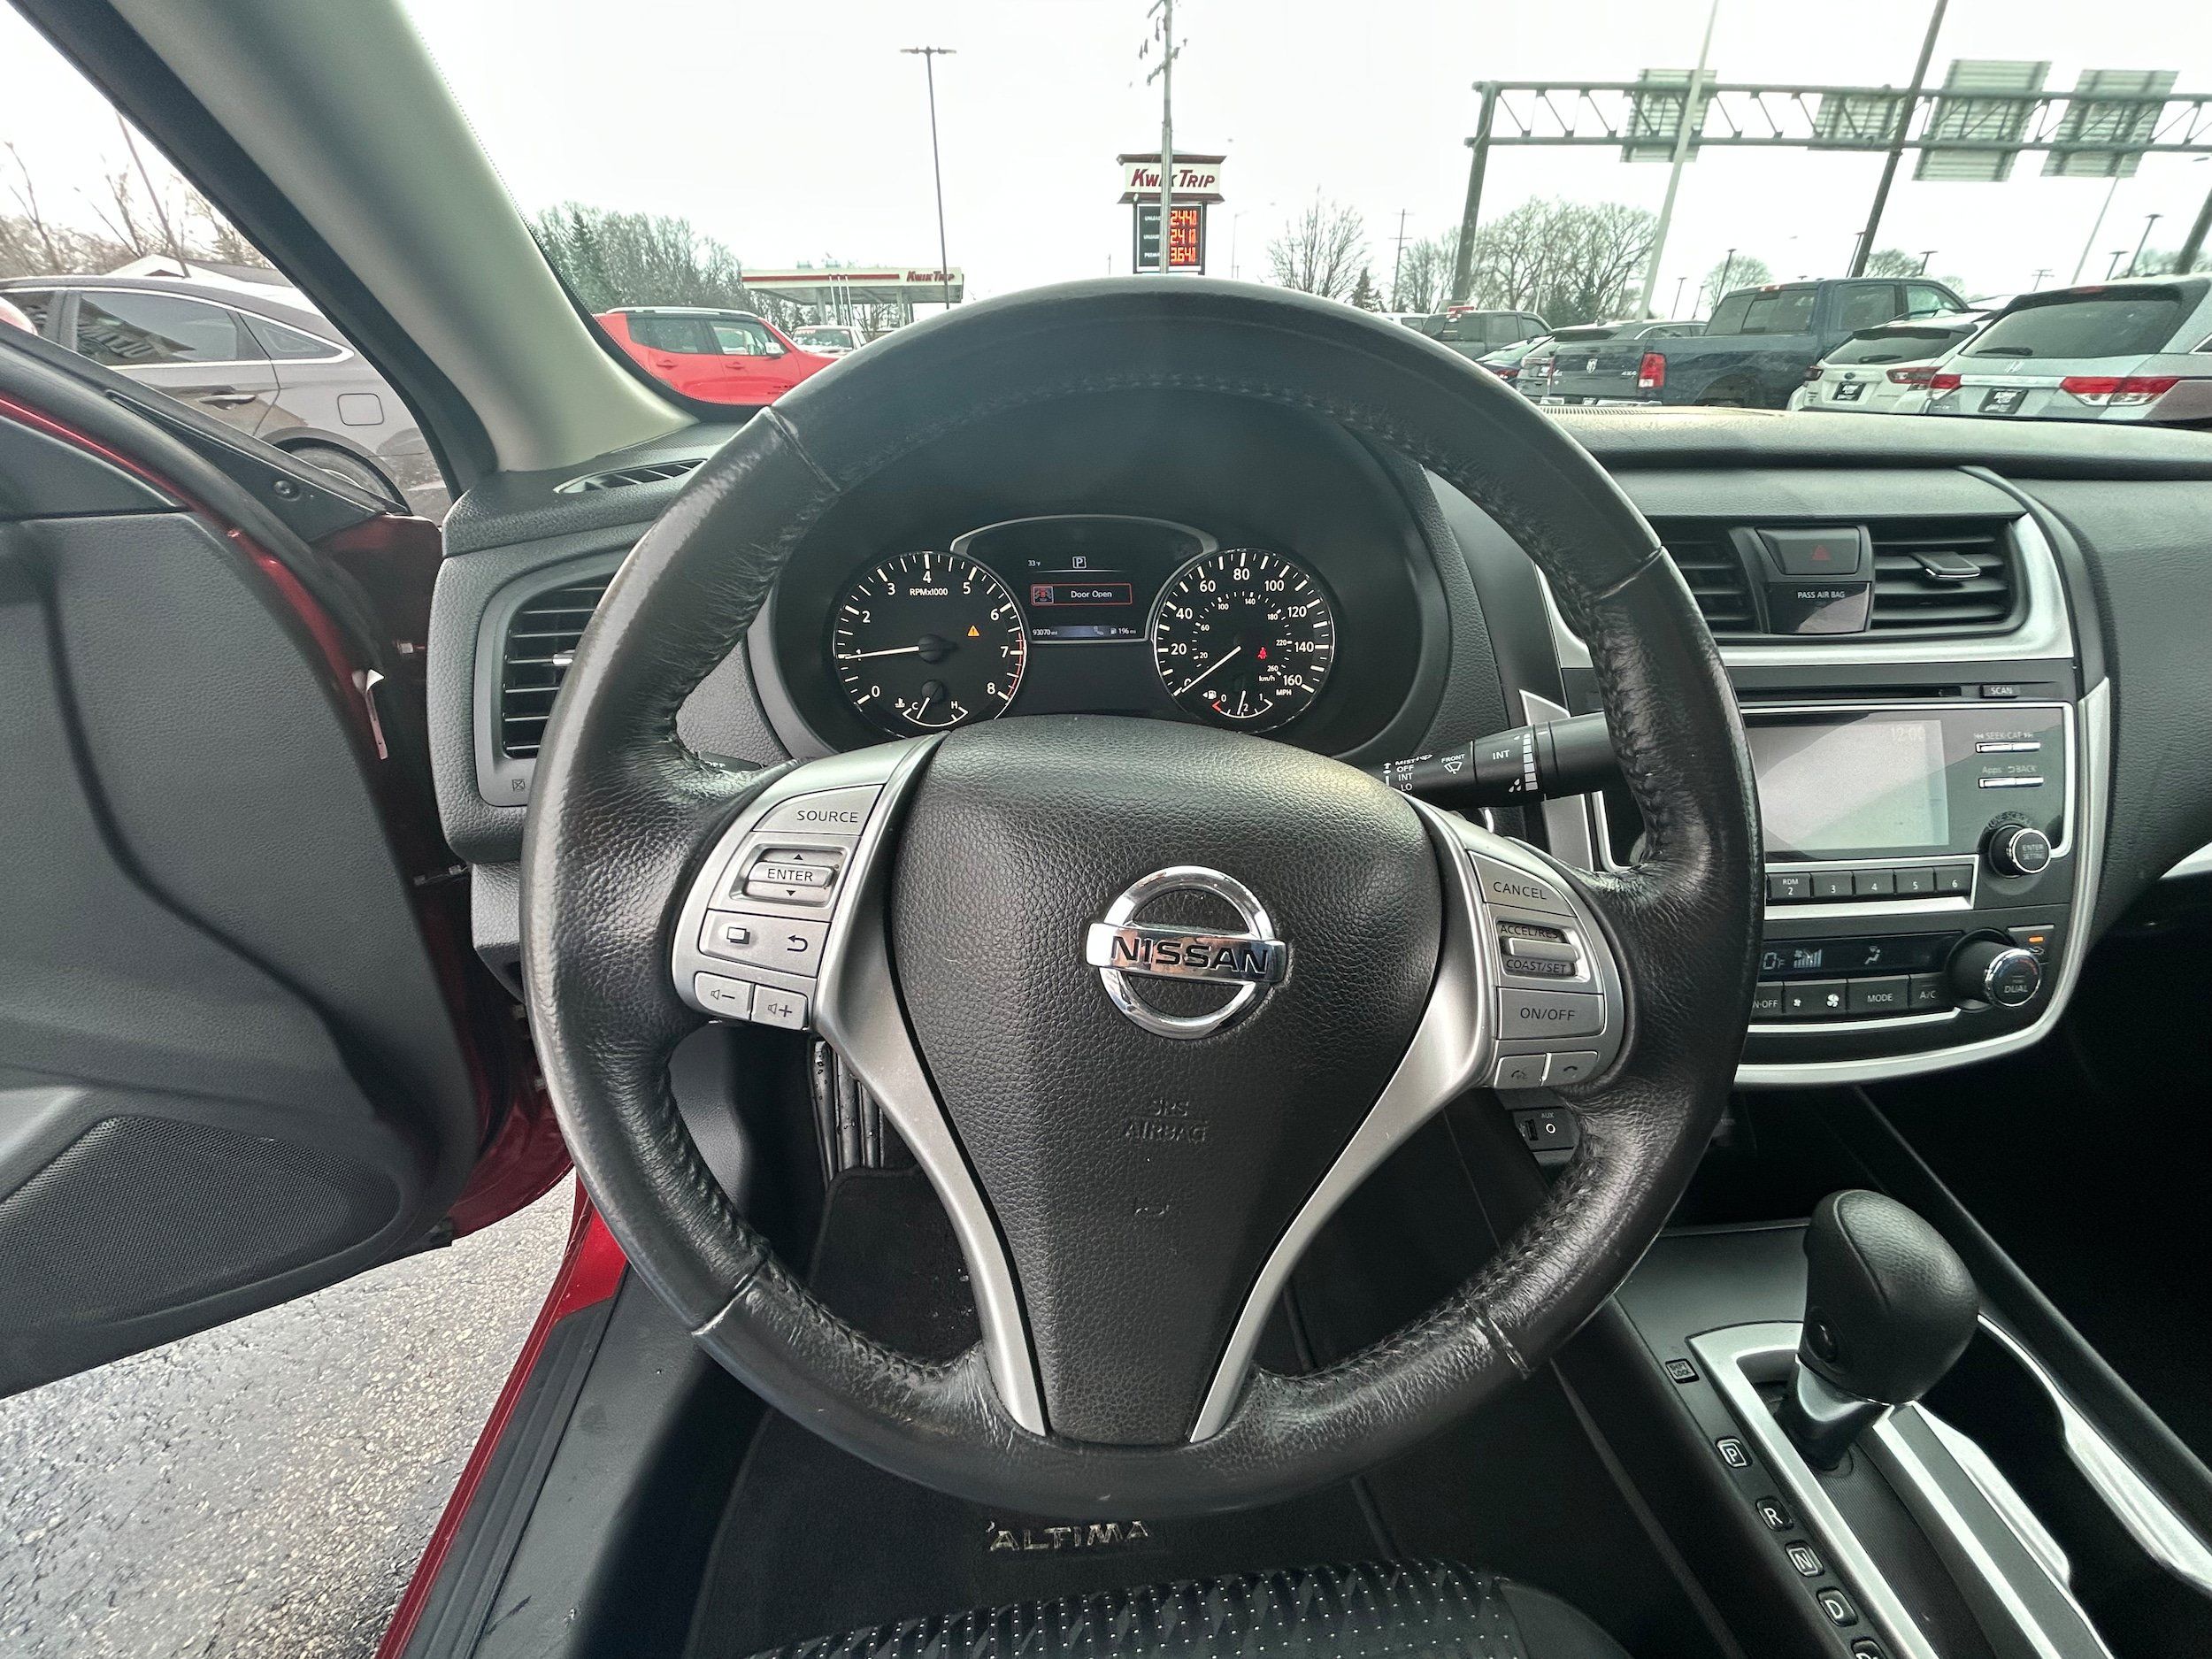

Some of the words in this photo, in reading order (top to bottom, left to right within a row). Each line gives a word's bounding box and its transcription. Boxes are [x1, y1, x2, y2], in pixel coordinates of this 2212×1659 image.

[1179, 169, 1216, 188] TRIP
[933, 271, 955, 282] TRP
[923, 571, 932, 583] 4
[1233, 568, 1249, 580] 80
[887, 582, 895, 595] 3
[910, 588, 949, 596] RPMx1000
[963, 582, 972, 595] 5
[1199, 580, 1216, 593] 60
[1264, 580, 1285, 592] 100
[1092, 590, 1112, 599] Open
[862, 611, 871, 623] 2
[990, 611, 999, 621] 6
[1176, 607, 1194, 620] 40
[1287, 606, 1307, 618] 120
[1000, 646, 1009, 658] 7
[1171, 643, 1187, 656] 20
[1294, 641, 1314, 653] 140
[1283, 674, 1302, 687] 160
[871, 685, 880, 697] 0
[987, 682, 995, 695] 8
[1221, 694, 1227, 703] 0
[911, 702, 918, 710] C
[951, 701, 958, 710] H
[1440, 753, 1466, 764] FRONT
[1493, 750, 1510, 760] INT
[1395, 758, 1416, 767] MIST
[1396, 764, 1415, 773] OFF
[1398, 772, 1414, 782] INT
[1401, 782, 1413, 792] LO
[796, 810, 859, 823] SOURCE
[767, 868, 813, 882] ENTER
[1830, 885, 1836, 894] 3
[1952, 879, 1958, 888] 6
[1494, 881, 1548, 901] CANCEL
[1787, 887, 1793, 895] 2
[1111, 936, 1269, 977] NISSAN
[1506, 959, 1567, 973] COAST/SET
[1919, 989, 1936, 1000] A/C
[2004, 985, 2028, 994] DUAL
[1867, 992, 1893, 1002] MODE
[1519, 1008, 1576, 1022] ON/OFF
[1728, 1448, 1738, 1463] P
[1764, 1508, 1783, 1525] R
[988, 1520, 1152, 1552] ALTIMA
[1795, 1553, 1811, 1570] N
[1827, 1599, 1843, 1619] D
